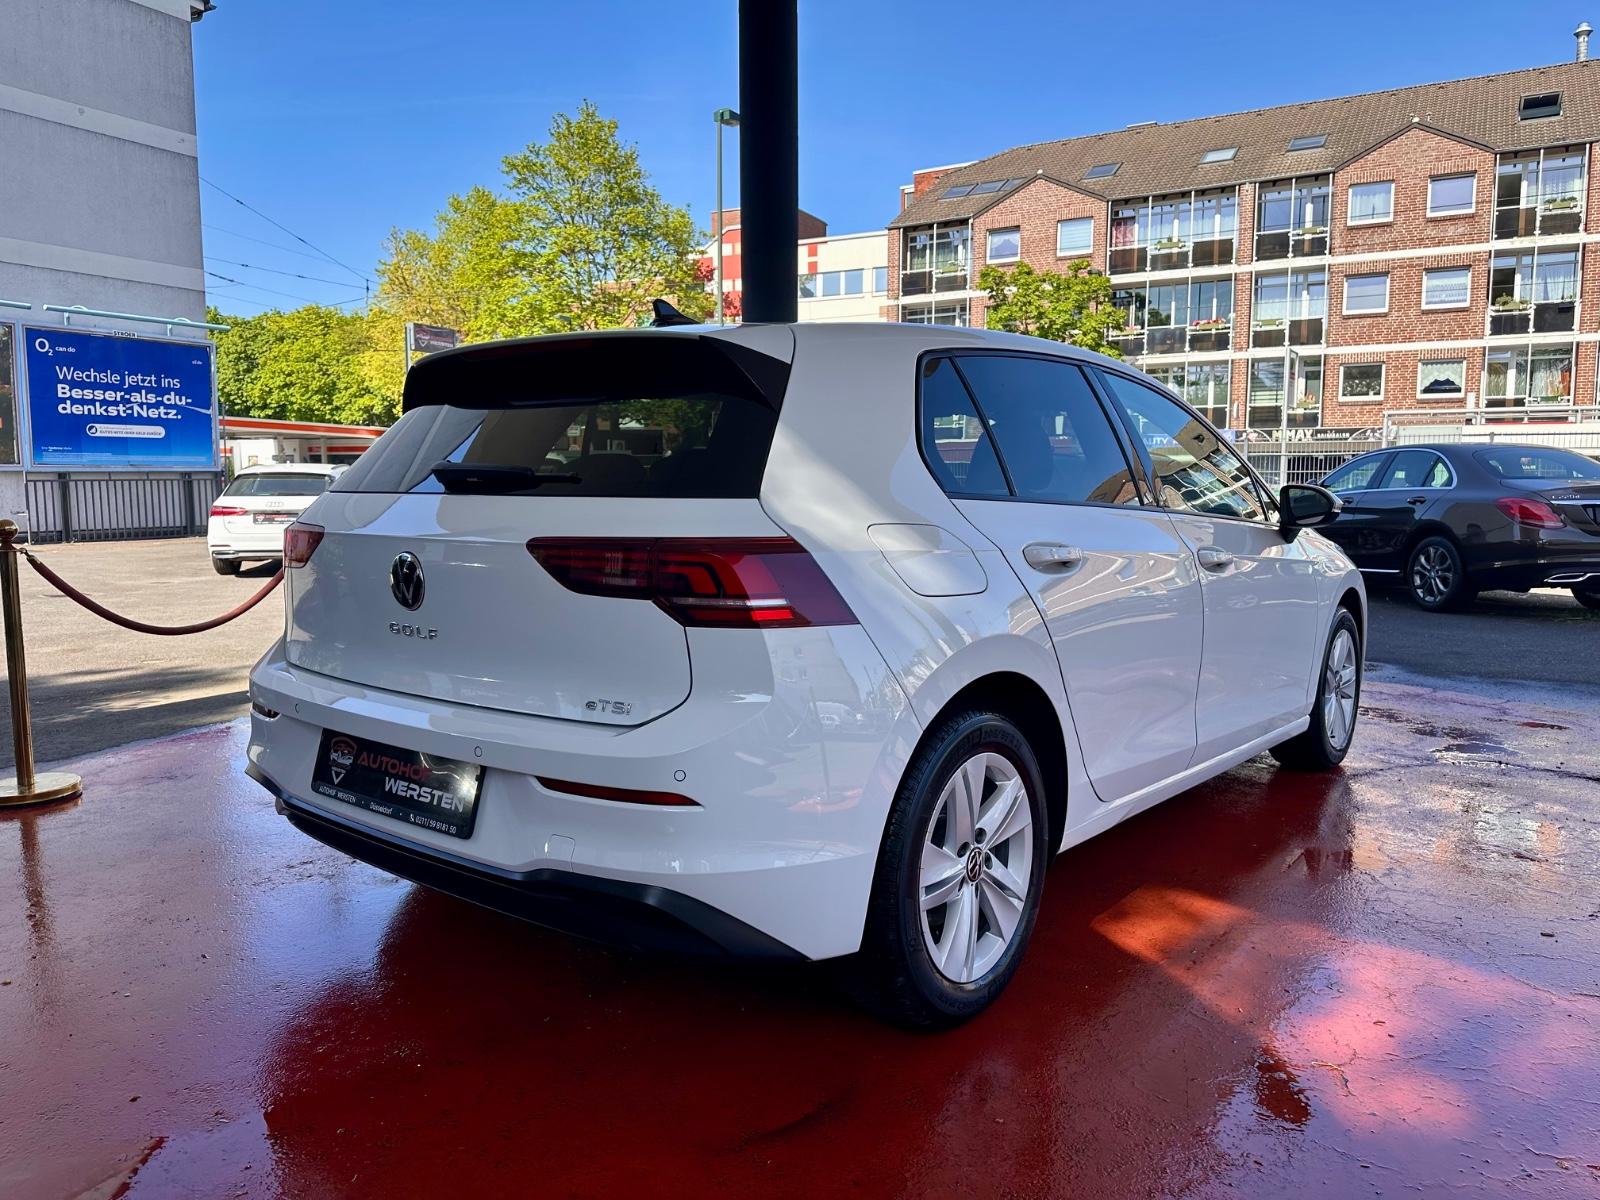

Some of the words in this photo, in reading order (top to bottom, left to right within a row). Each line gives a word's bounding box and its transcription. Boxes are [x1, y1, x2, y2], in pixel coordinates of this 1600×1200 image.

[56, 365, 121, 384] Wechsle
[123, 371, 158, 389] jetzt
[161, 374, 181, 389] ins
[57, 383, 193, 406] Besser-als-du-
[57, 400, 182, 420] denkst-Netz.
[1271, 429, 1314, 442] MMAX
[389, 621, 438, 640] GOLF
[385, 776, 465, 813] WERSTEN
[369, 801, 393, 816] Düsseldorf
